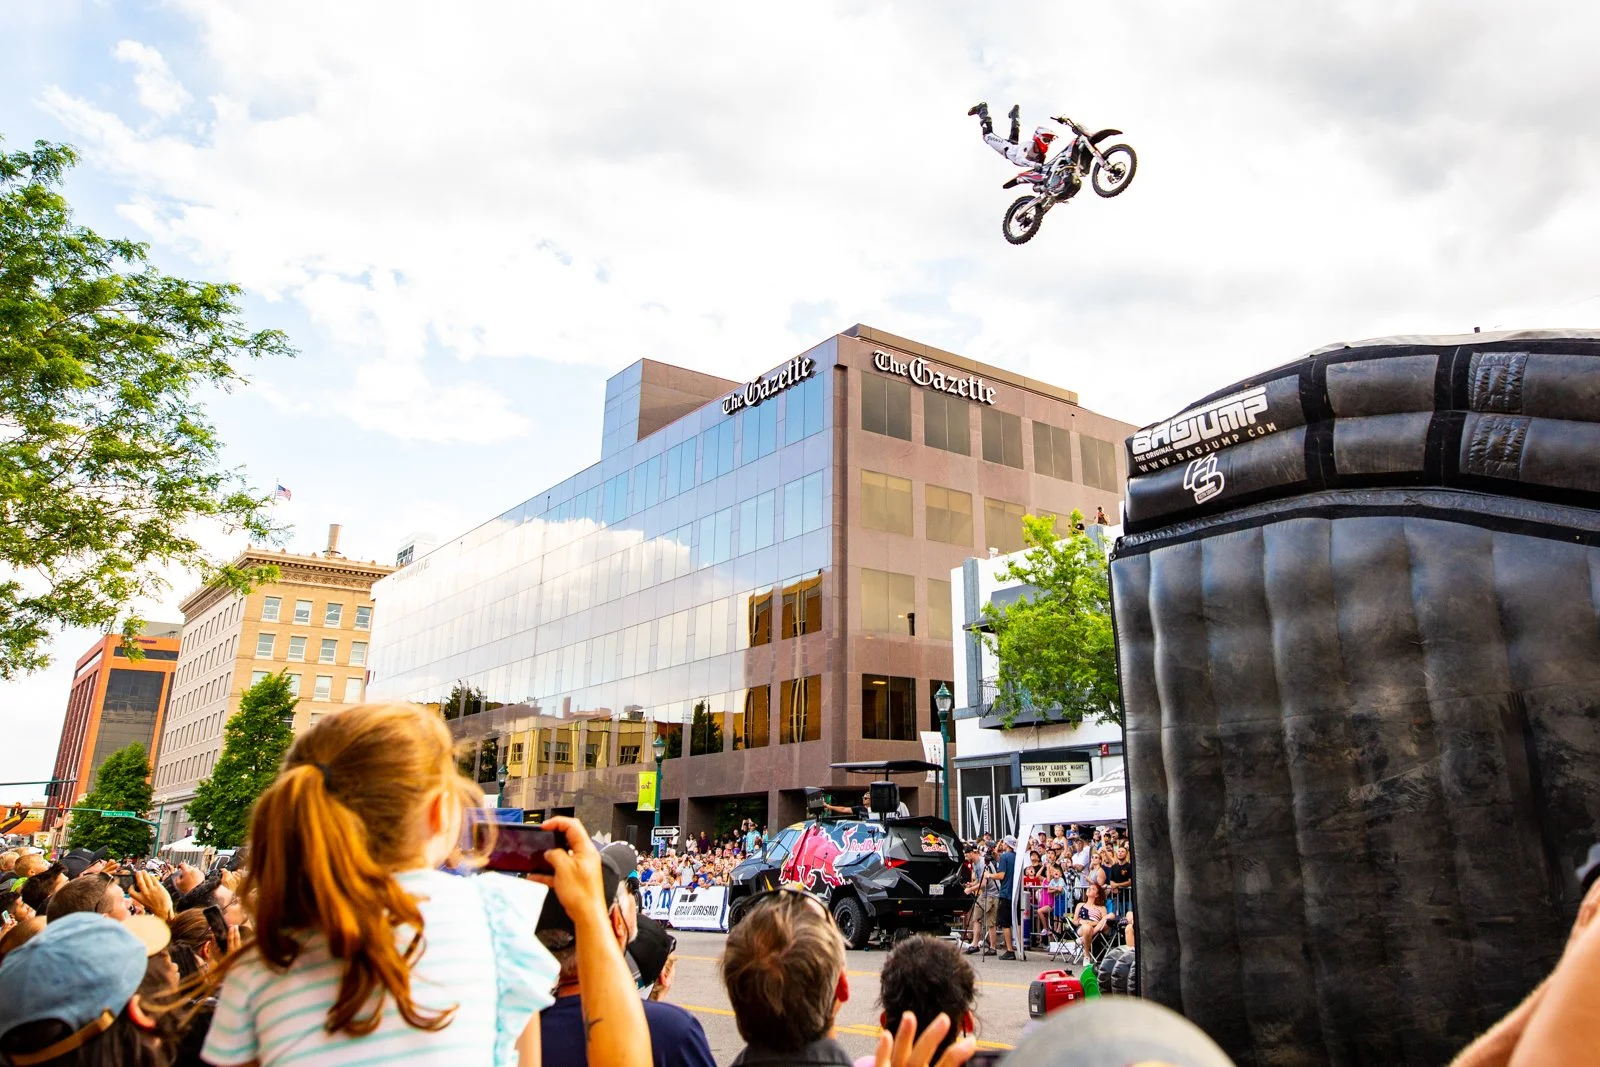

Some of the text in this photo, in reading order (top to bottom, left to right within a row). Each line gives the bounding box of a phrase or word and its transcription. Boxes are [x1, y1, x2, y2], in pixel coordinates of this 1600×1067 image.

[722, 356, 811, 415] The Gazette
[874, 350, 997, 405] The Gazette
[1132, 387, 1268, 455] BAGJUMP
[1134, 445, 1174, 463] THE ORIGINAL
[675, 905, 718, 917] GRAN TURISMO
